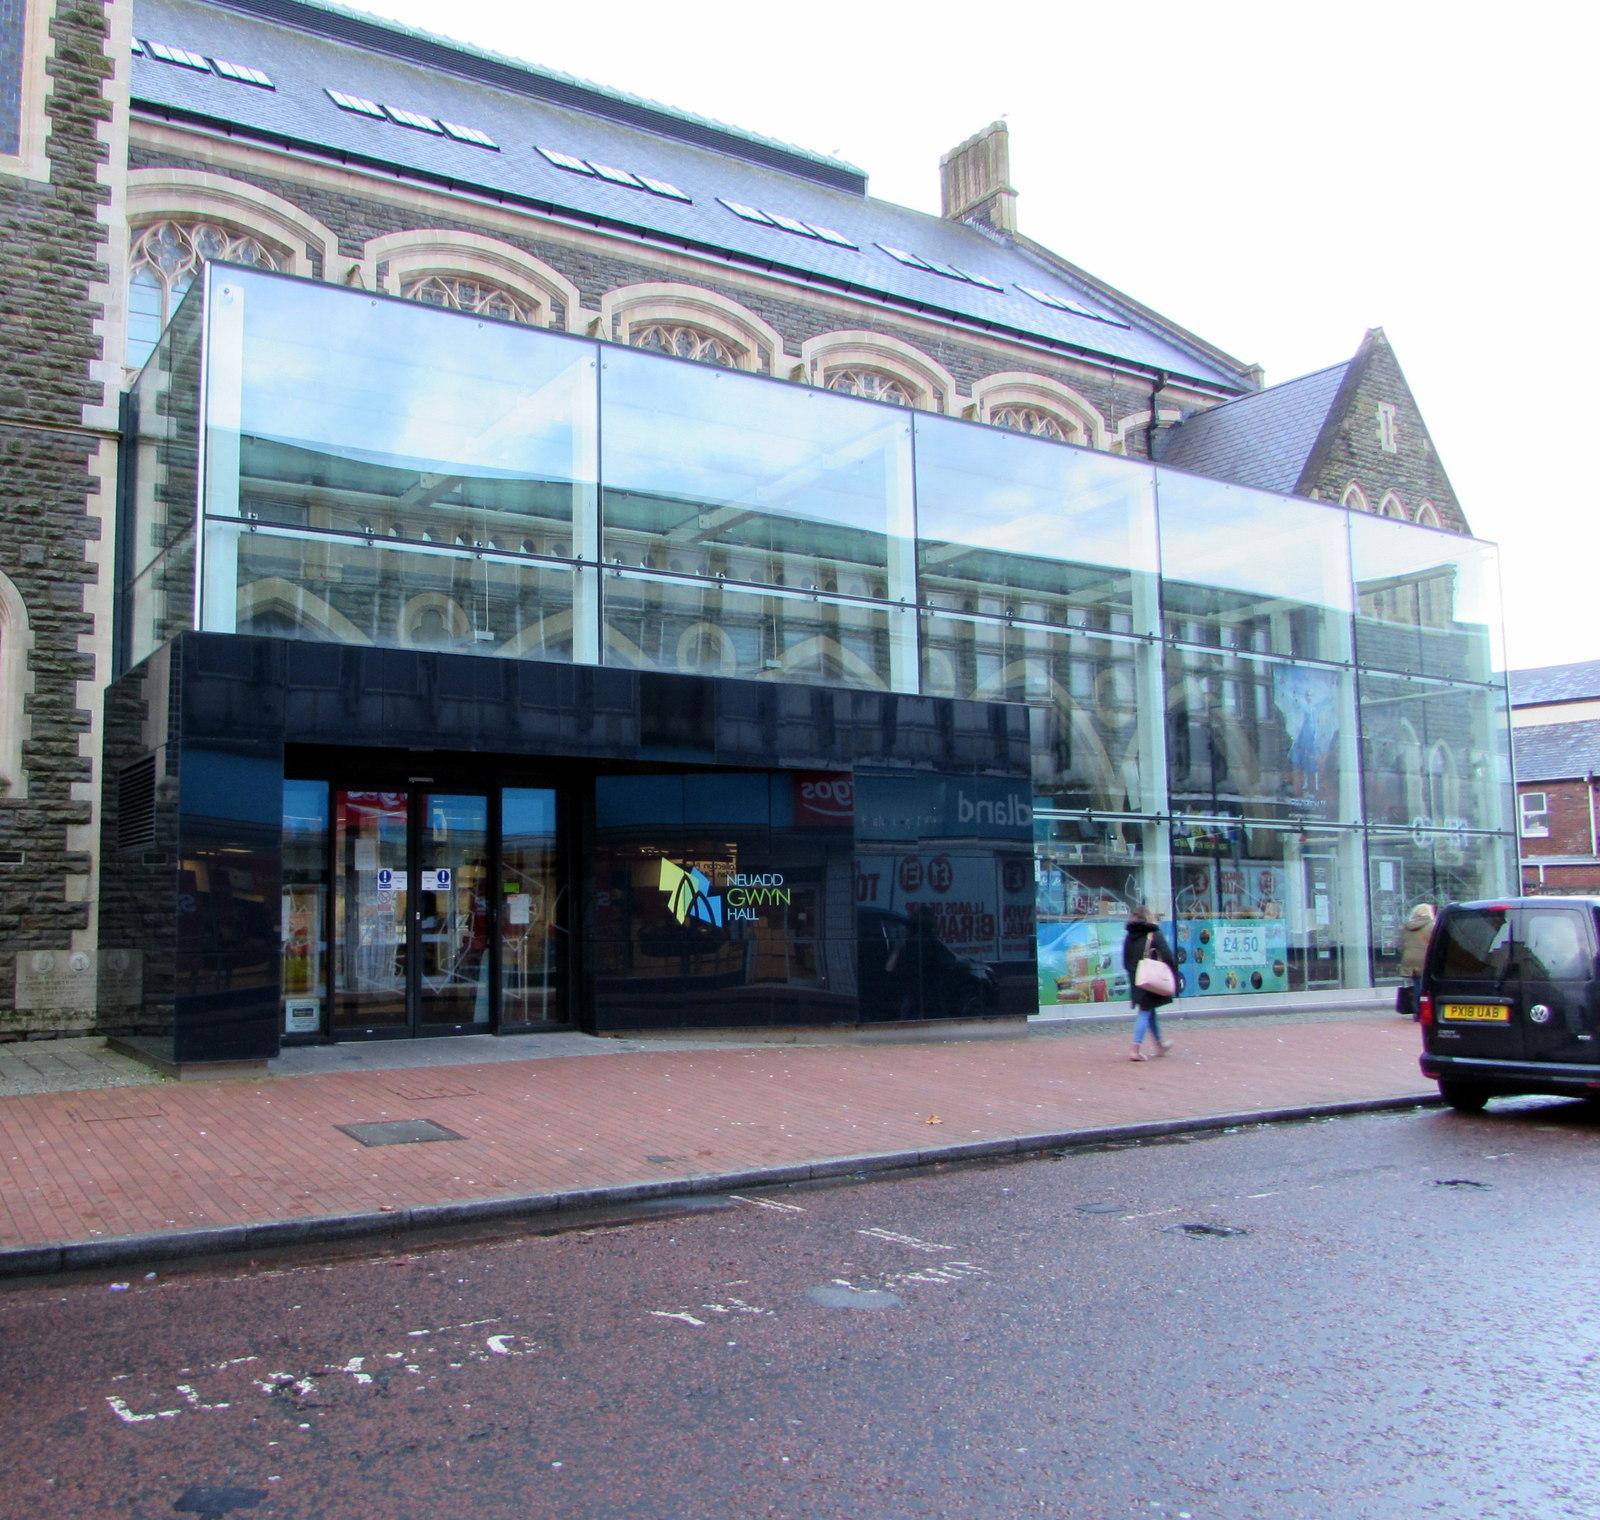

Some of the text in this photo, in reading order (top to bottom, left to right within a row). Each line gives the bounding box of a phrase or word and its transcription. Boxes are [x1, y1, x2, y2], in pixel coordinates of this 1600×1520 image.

[727, 873, 783, 886] NEUADD
[727, 888, 791, 906] GWYN
[727, 908, 760, 921] HALL
[1223, 936, 1259, 953] £4.50
[1451, 1006, 1500, 1019] PX18 UAB
